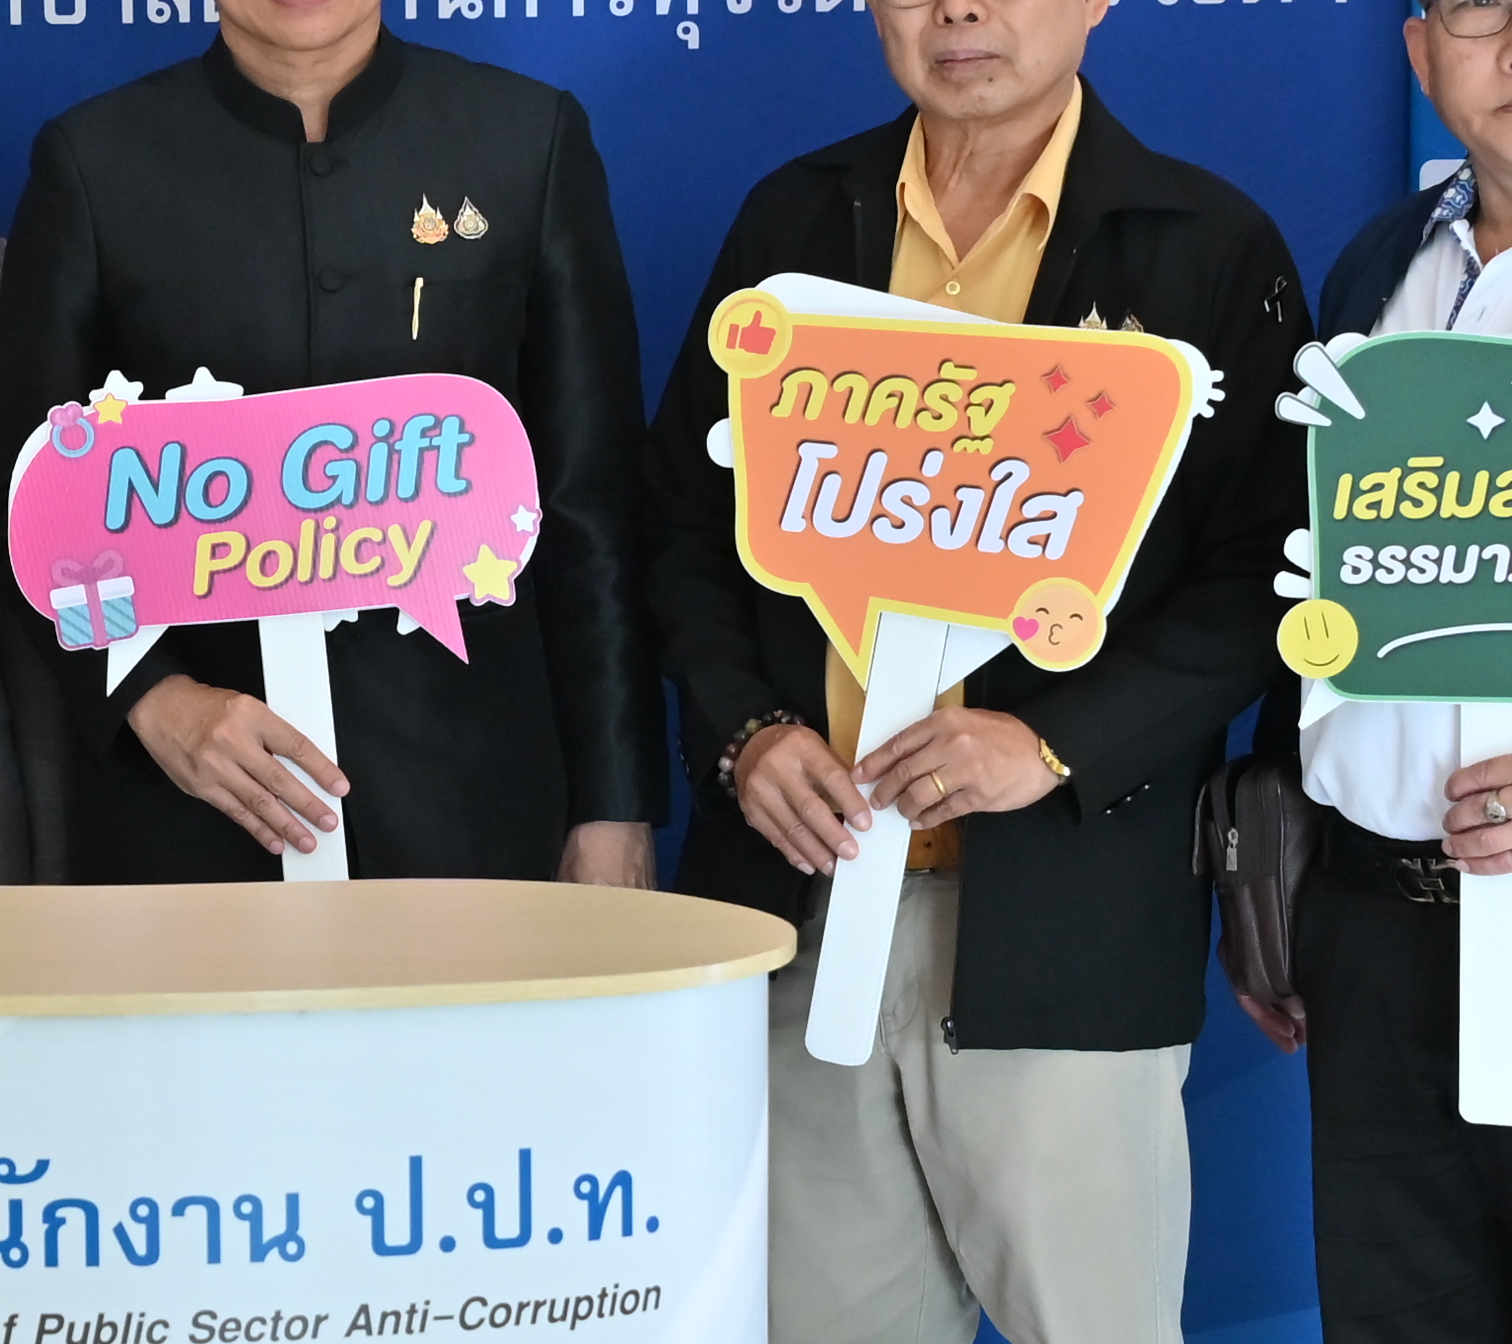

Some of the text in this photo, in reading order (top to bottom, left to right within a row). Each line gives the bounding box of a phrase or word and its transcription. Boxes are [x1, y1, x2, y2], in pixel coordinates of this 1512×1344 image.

[772, 360, 1017, 455] ภาครัฐ
[104, 413, 475, 533] No Gift
[779, 440, 1085, 562] โปร่งใส
[192, 515, 436, 600] Policy
[354, 1147, 660, 1257] ป.ป.ท.
[187, 1309, 329, 1343] Sector
[344, 1282, 662, 1338] Anti-Corruption
